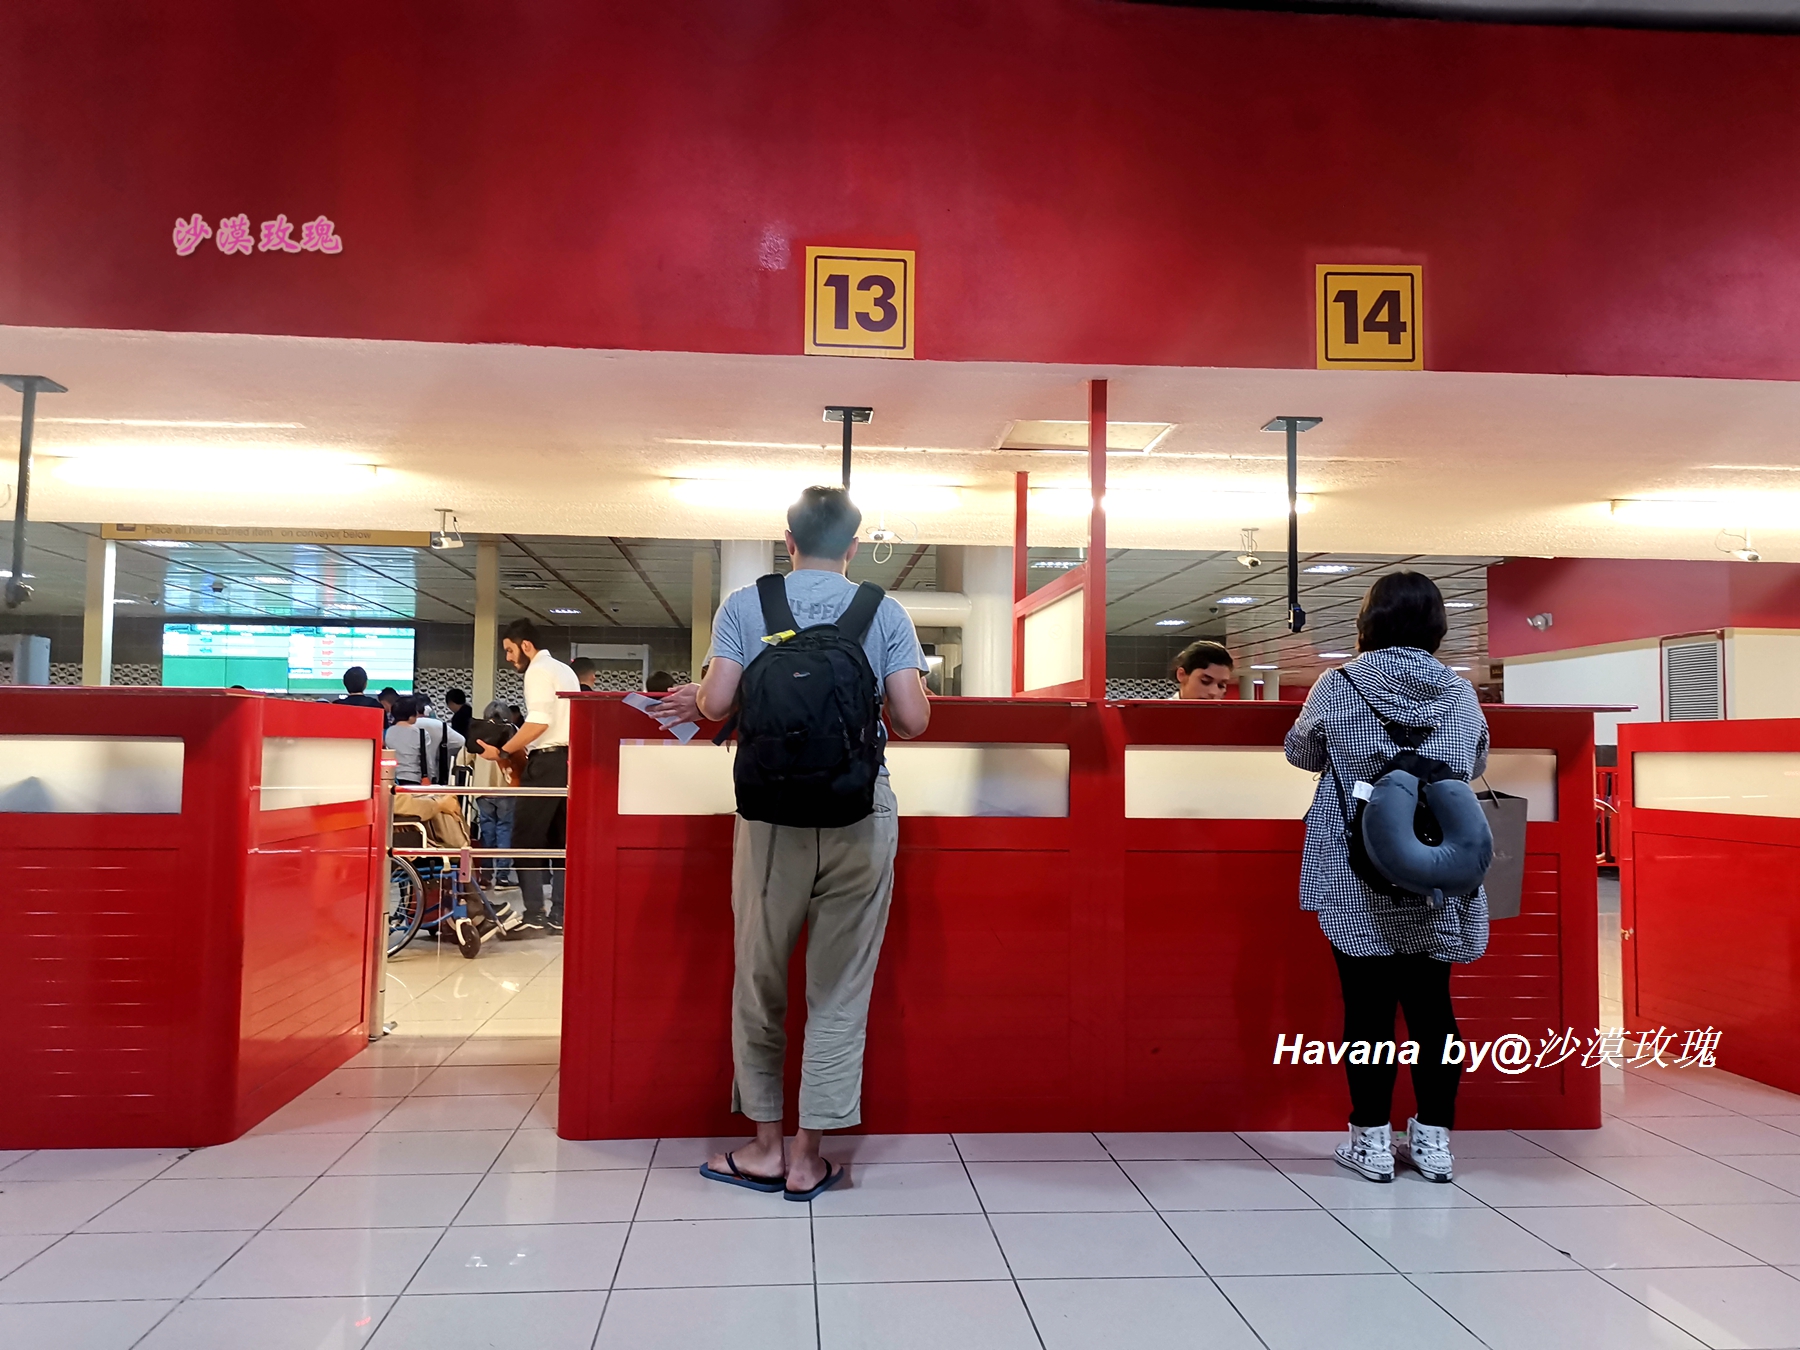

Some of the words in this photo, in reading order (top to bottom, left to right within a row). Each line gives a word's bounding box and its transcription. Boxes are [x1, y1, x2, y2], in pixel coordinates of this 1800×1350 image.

[823, 273, 898, 333] 13
[1332, 289, 1407, 345] 14
[144, 524, 172, 535] Place
[175, 525, 187, 535] all
[189, 525, 213, 536] hand
[343, 530, 372, 539] below
